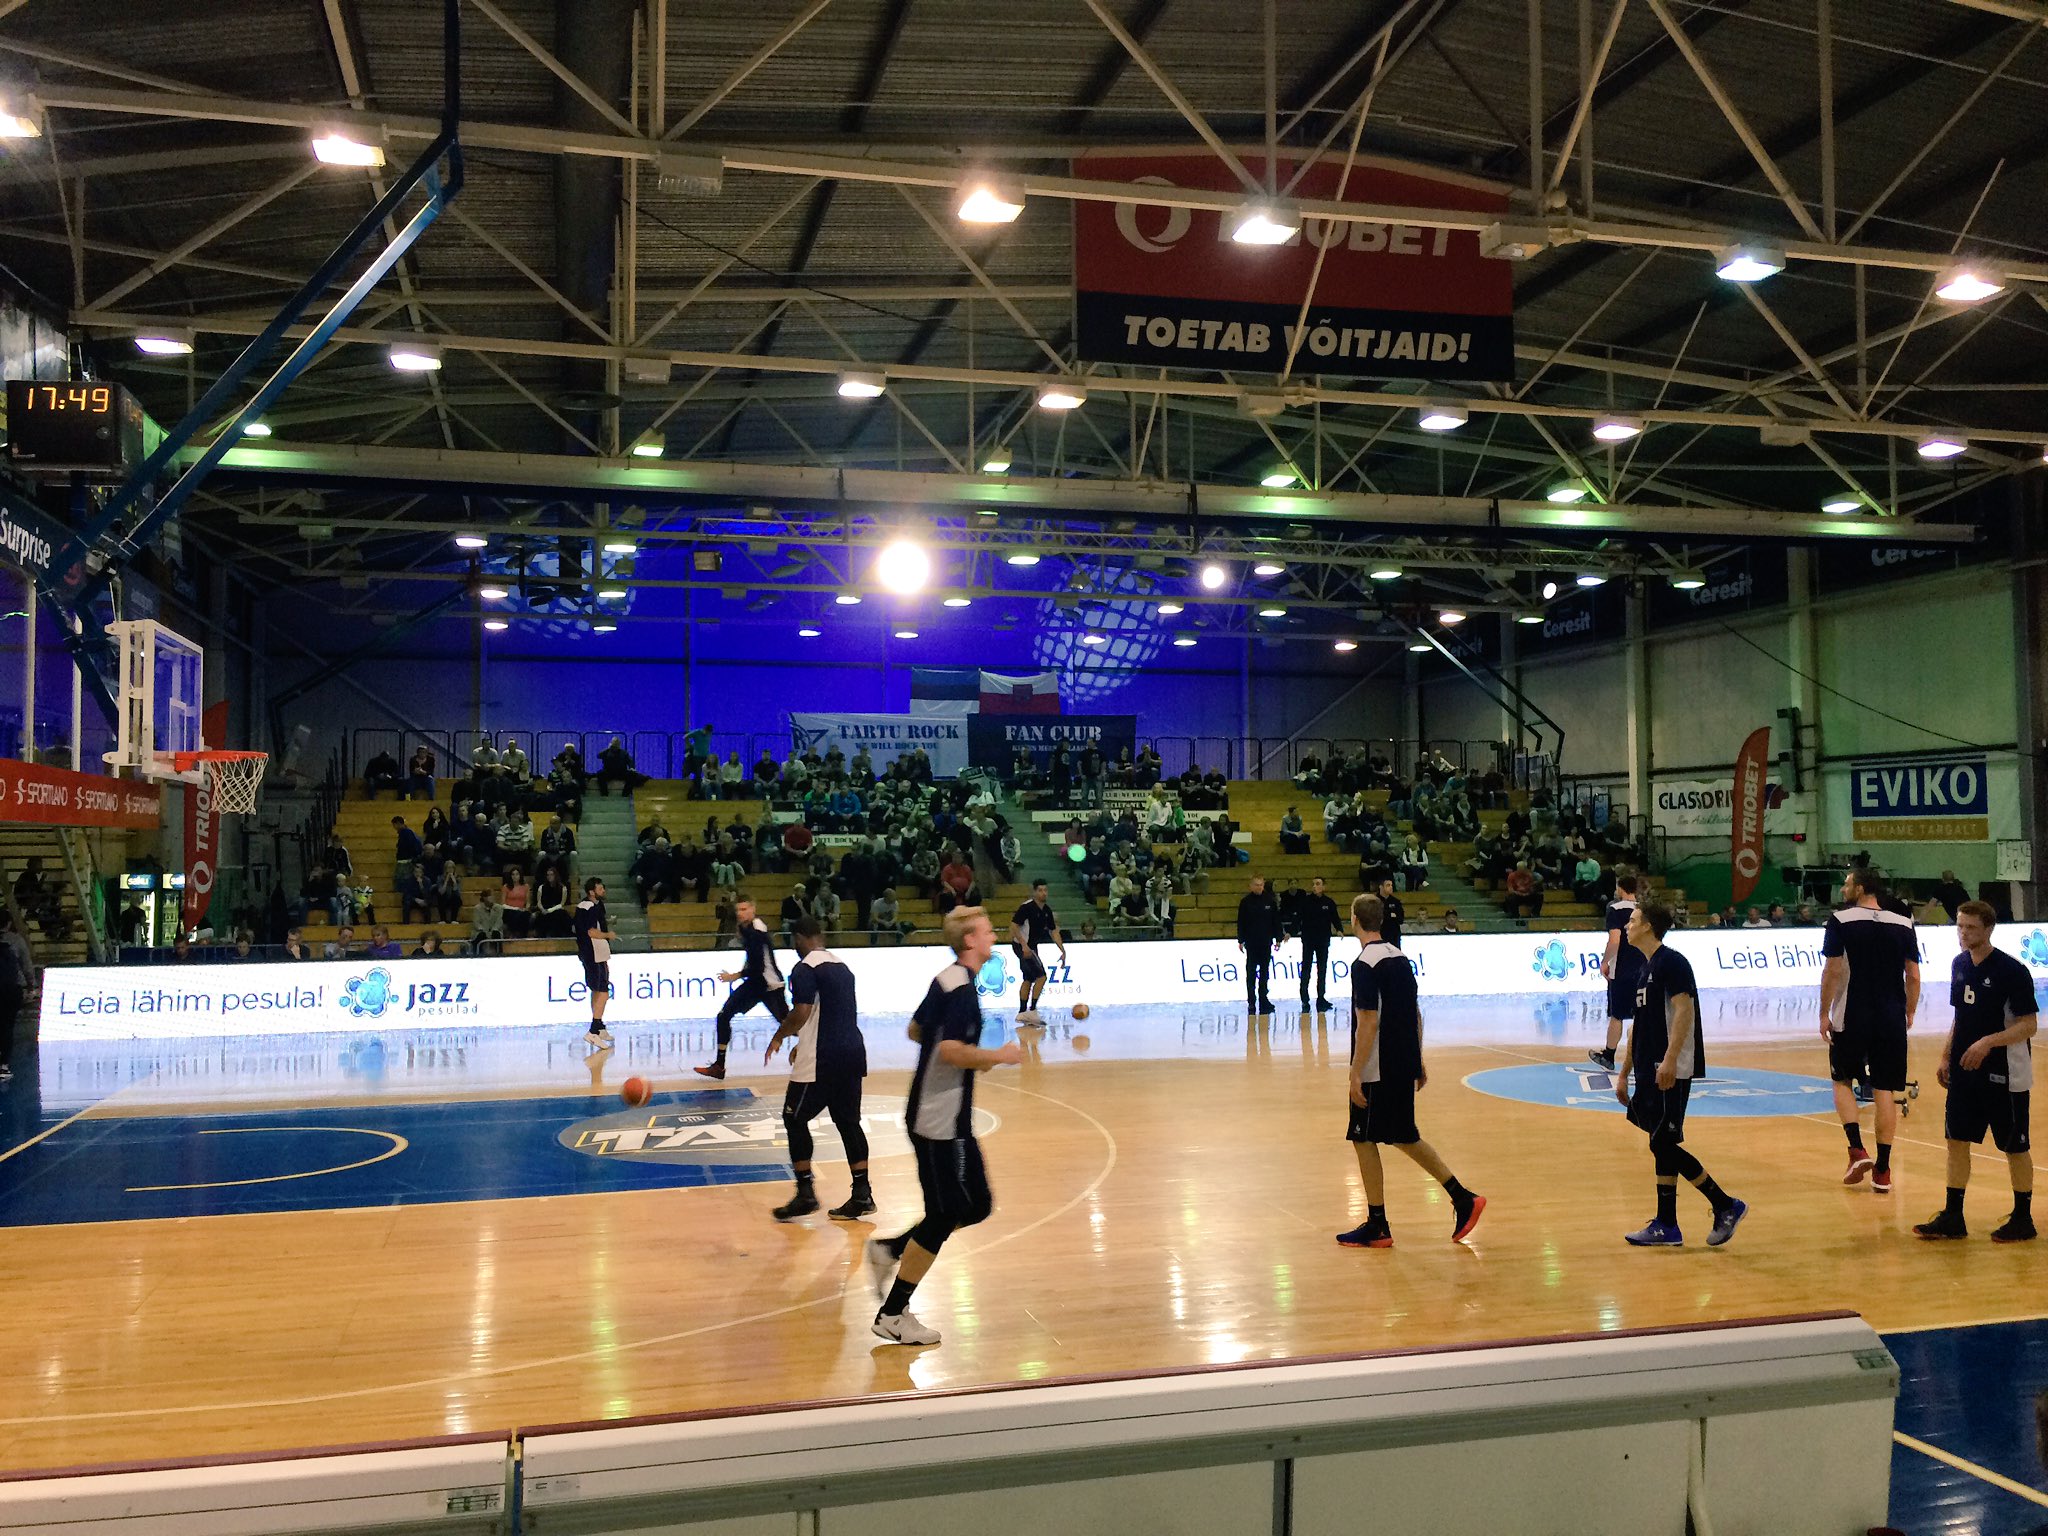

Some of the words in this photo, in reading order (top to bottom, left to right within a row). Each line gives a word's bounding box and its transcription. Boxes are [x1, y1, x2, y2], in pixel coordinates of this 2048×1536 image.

[1124, 314, 1271, 353] TOETAB
[1283, 317, 1473, 363] VÕITJAID!
[27, 386, 110, 413] 17:49
[0, 507, 52, 570] Surprise
[1689, 572, 1753, 607] Ceresit
[1542, 610, 1591, 639] Ceresit
[838, 724, 901, 740] TARTU
[908, 724, 959, 740] ROCK
[871, 742, 893, 750] WILL
[1004, 725, 1044, 741] FAN
[1049, 725, 1102, 741] CLUB
[1742, 752, 1760, 844] TRIOBET
[1859, 764, 1978, 808] EVIKO
[1181, 958, 1239, 983] Leia
[1716, 946, 1768, 970] Leia
[59, 990, 120, 1015] Leia
[132, 988, 211, 1014] lähim
[221, 984, 323, 1016] pesula!
[548, 976, 615, 1002] Lea
[628, 971, 716, 999] lähim
[1963, 984, 1977, 1005] 6
[418, 1003, 479, 1018] pesulad
